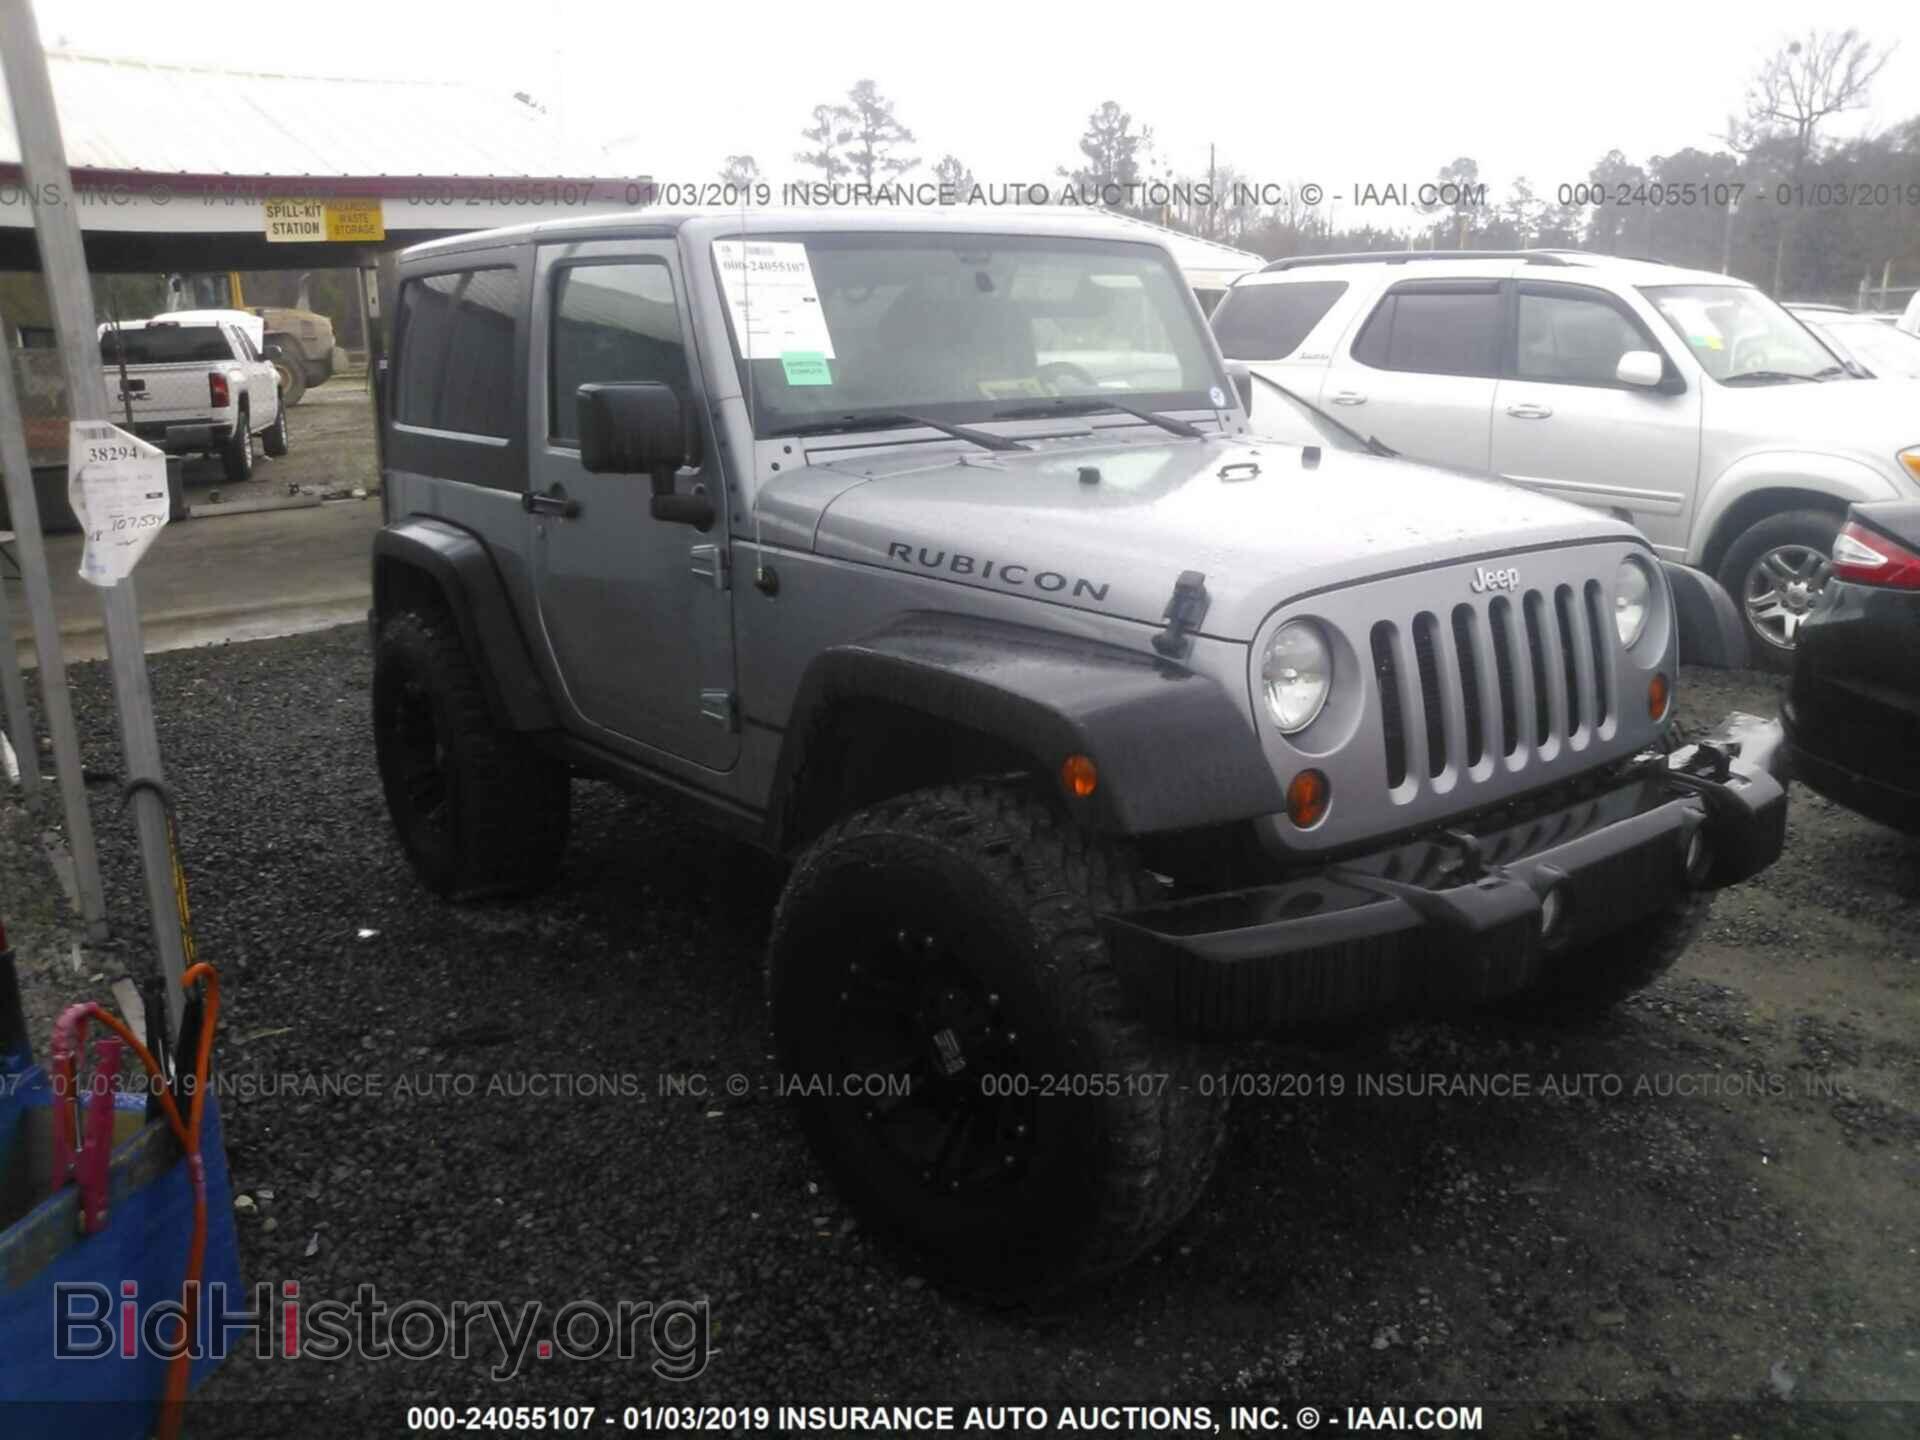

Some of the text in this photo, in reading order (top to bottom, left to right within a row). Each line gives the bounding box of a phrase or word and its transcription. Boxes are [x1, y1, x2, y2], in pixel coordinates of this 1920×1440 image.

[266, 204, 322, 235] SPILL-KIT STATION
[89, 447, 138, 463] 38294
[887, 541, 1111, 602] RUBICON
[1471, 567, 1520, 593] Jeep
